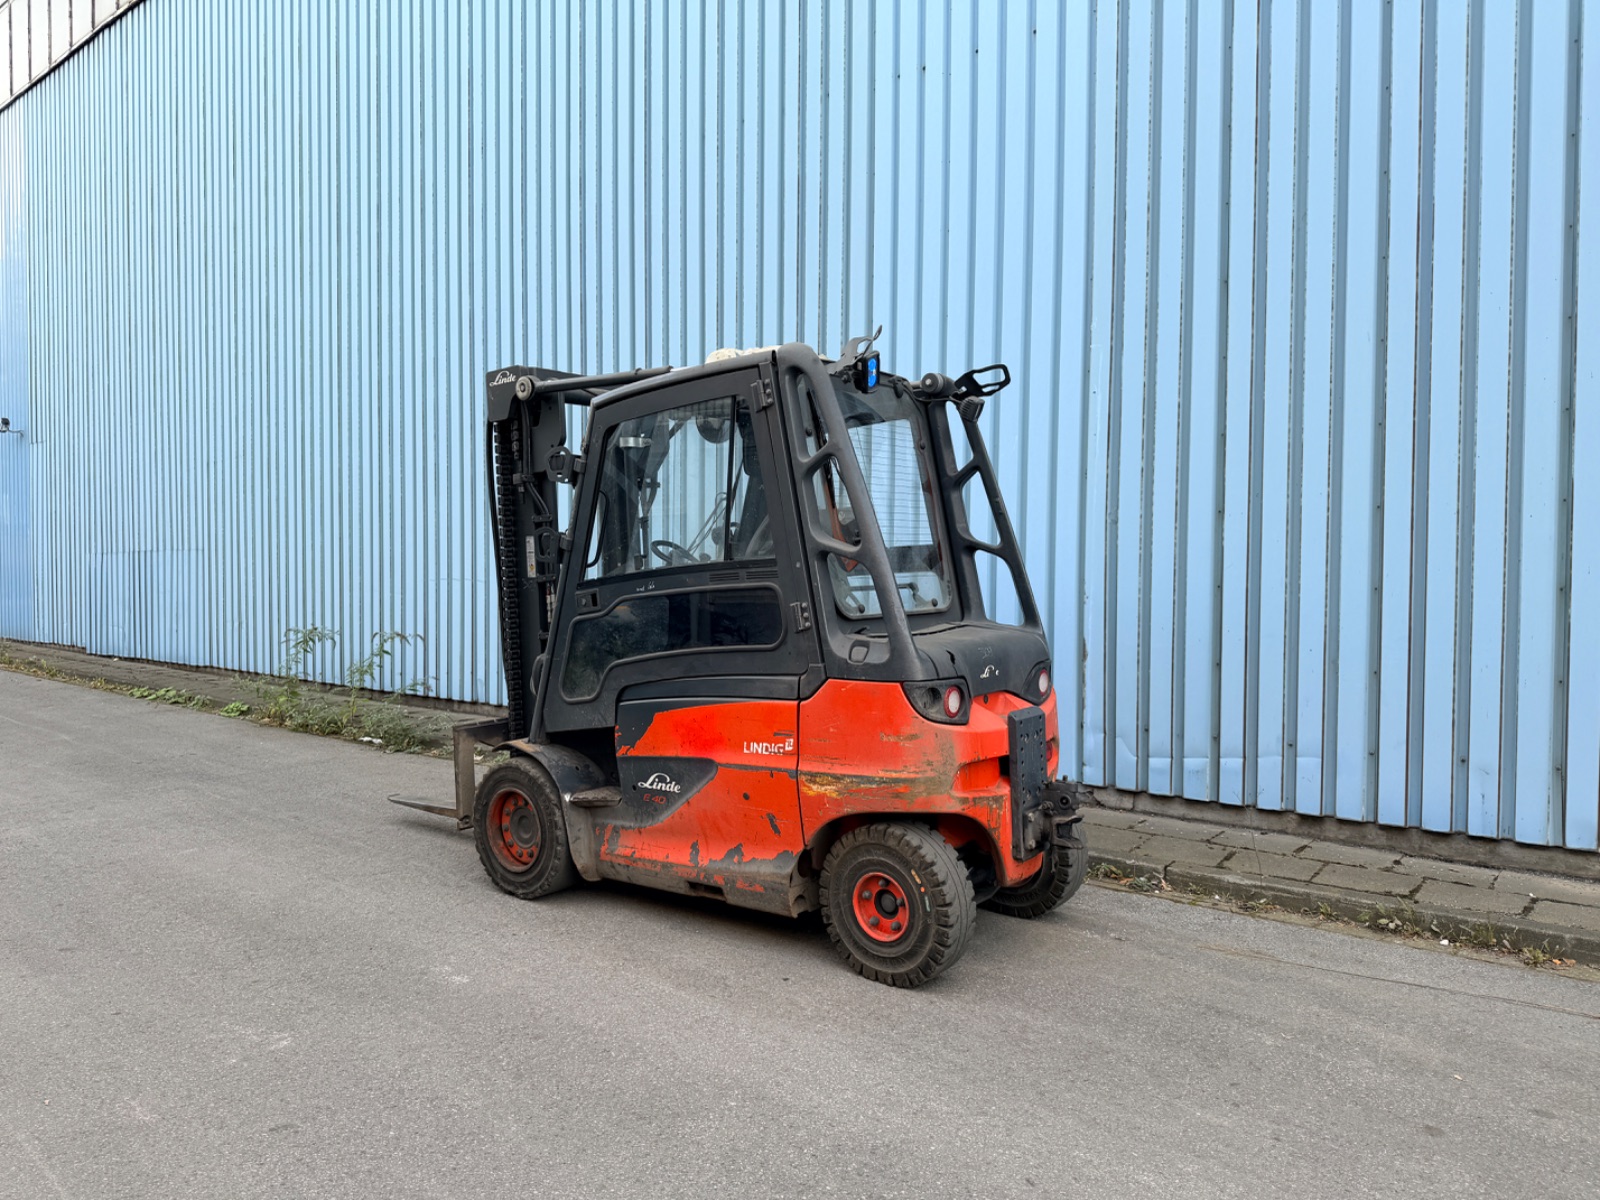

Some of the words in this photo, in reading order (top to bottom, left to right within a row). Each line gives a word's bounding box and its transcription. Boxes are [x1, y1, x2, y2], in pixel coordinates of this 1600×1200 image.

[489, 370, 516, 387] Linde
[980, 664, 999, 679] Lie
[743, 741, 784, 756] LINDIG
[637, 772, 681, 793] Linde
[643, 793, 651, 802] E
[651, 796, 667, 804] 40
